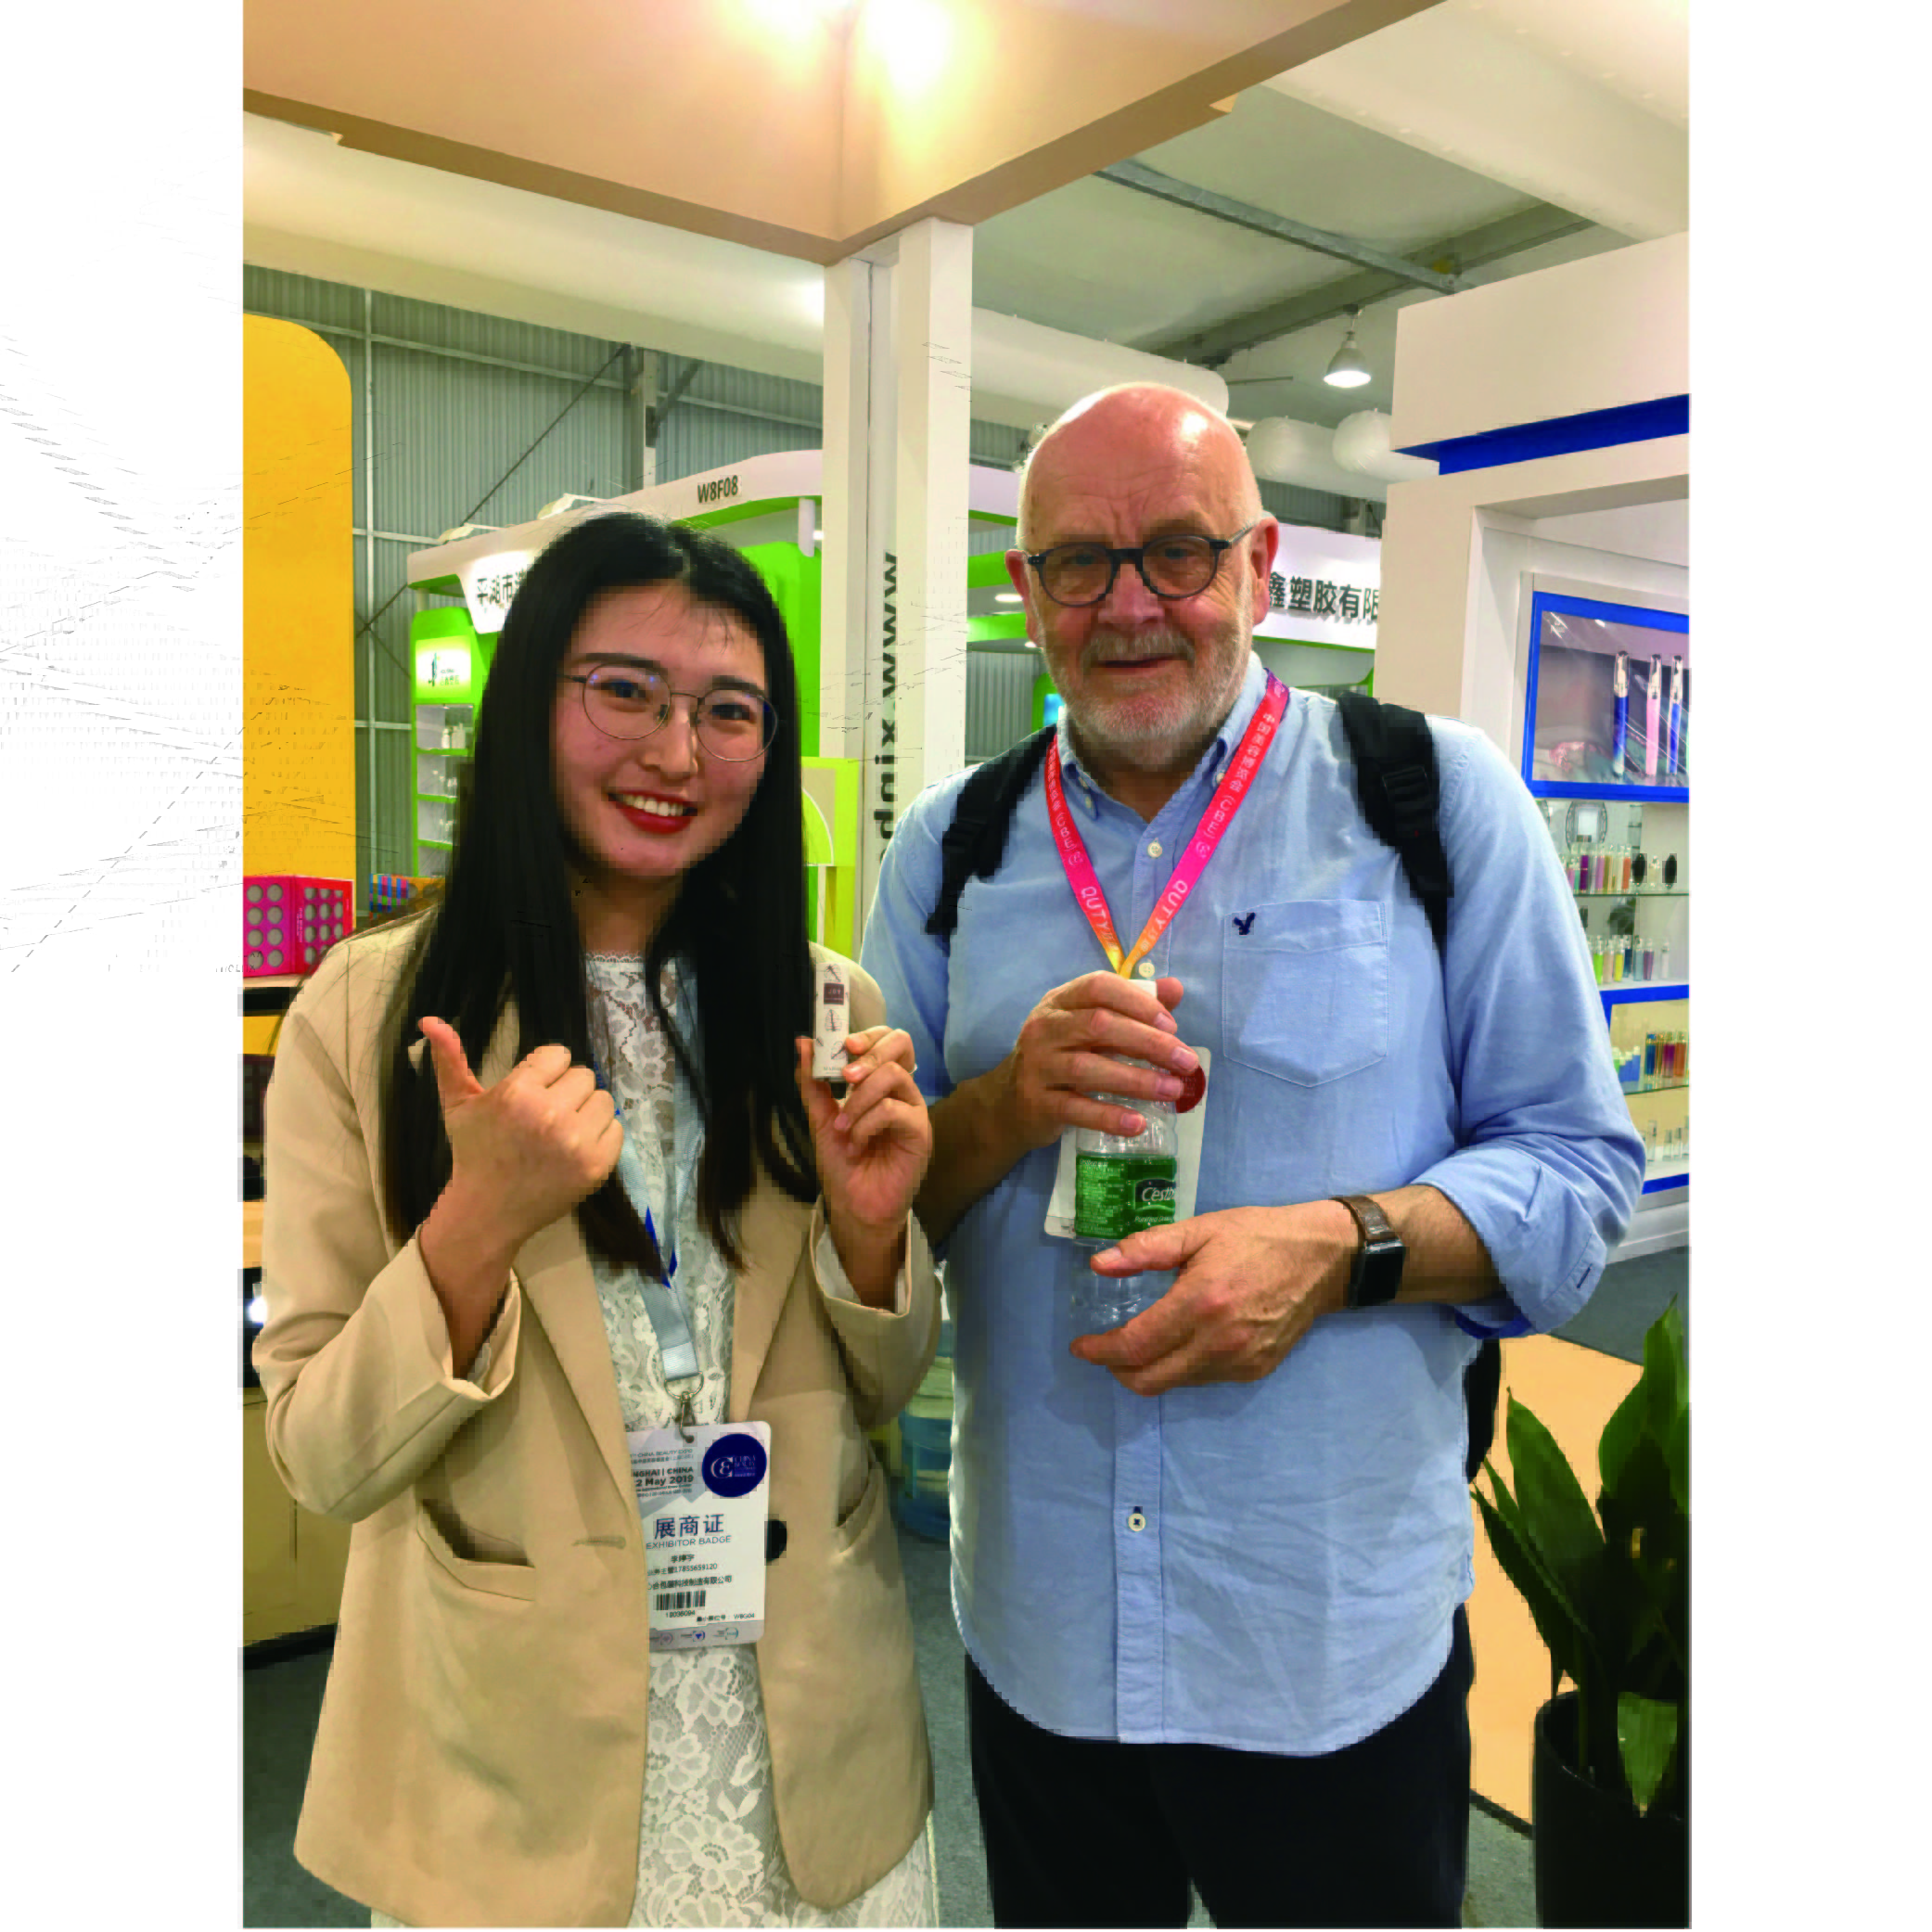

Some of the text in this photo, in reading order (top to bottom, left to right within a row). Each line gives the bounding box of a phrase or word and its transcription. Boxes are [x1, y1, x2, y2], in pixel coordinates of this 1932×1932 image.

[697, 475, 738, 504] W8F08
[666, 1465, 694, 1475] CHINA
[645, 1478, 666, 1487] May
[669, 1474, 695, 1485] 2019
[654, 1513, 724, 1540] 展商证
[646, 1534, 732, 1550] EXHIBITOR BADGE
